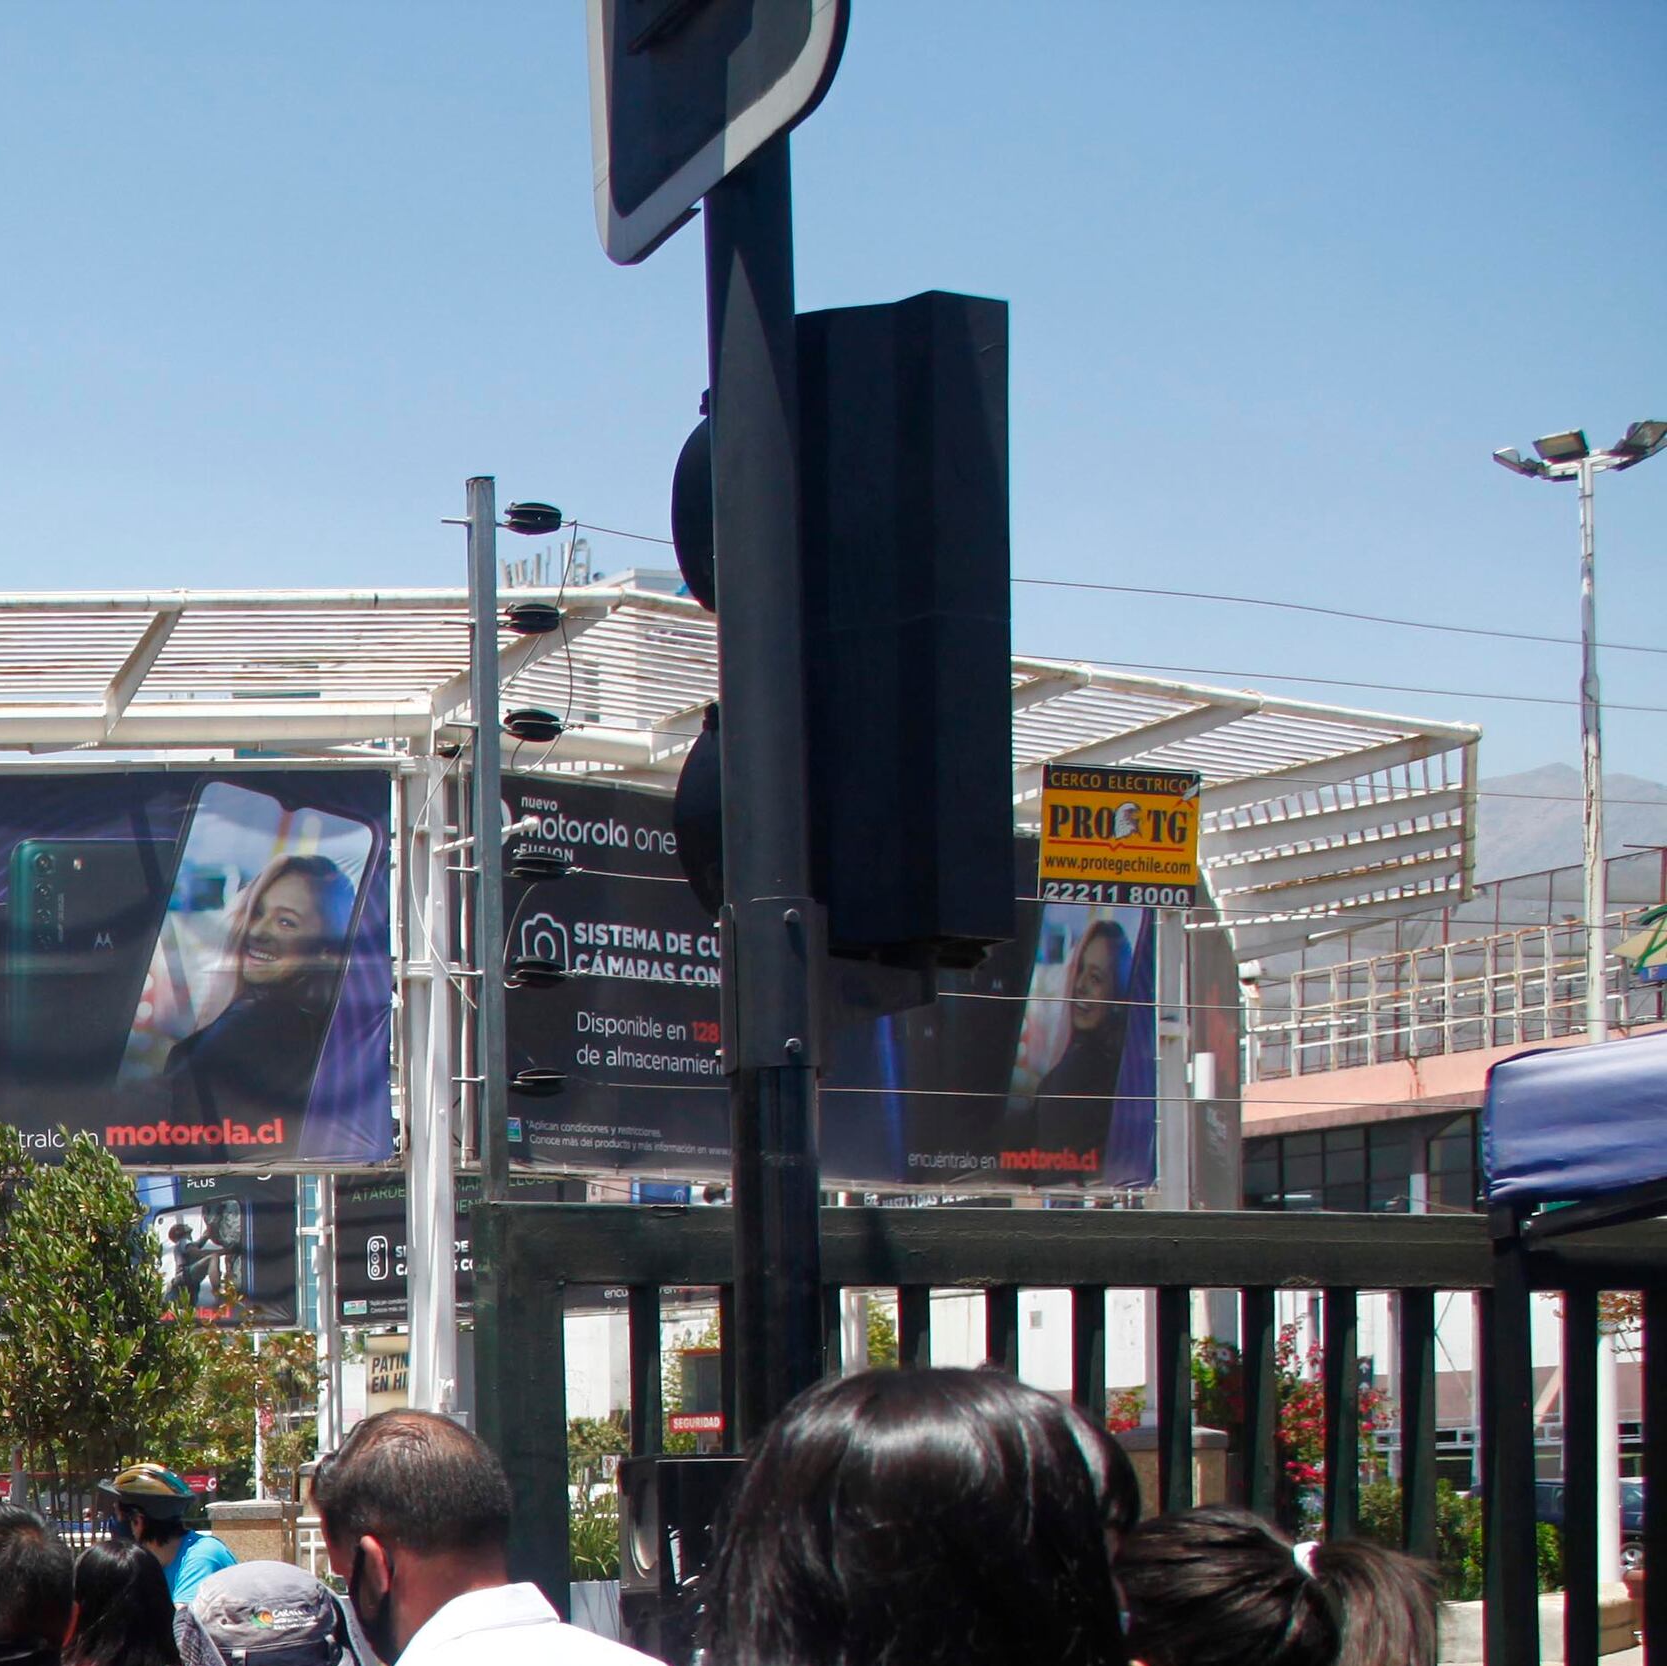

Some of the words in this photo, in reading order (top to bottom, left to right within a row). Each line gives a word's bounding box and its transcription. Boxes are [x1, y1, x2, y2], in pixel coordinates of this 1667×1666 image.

[1050, 772, 1101, 788] CERCO
[520, 796, 558, 812] nuevo
[634, 827, 677, 854] one
[1045, 855, 1191, 875] www.protegechile.com
[1045, 882, 1118, 902] 22211
[1129, 886, 1189, 906] 8000
[573, 922, 662, 952] SISTEMA
[666, 932, 692, 956] DE
[575, 949, 677, 984] CÁMARAS
[576, 1011, 663, 1038] Disponible
[666, 1023, 687, 1041] en
[691, 1021, 721, 1043] 128
[576, 1043, 601, 1066] de
[105, 1118, 284, 1147] motorola.cl
[980, 1155, 997, 1169] en
[999, 1148, 1099, 1171] motorola.cl
[371, 1352, 409, 1375] PATIN
[371, 1375, 389, 1394] EN
[672, 1416, 721, 1430] SEGURIDAD
